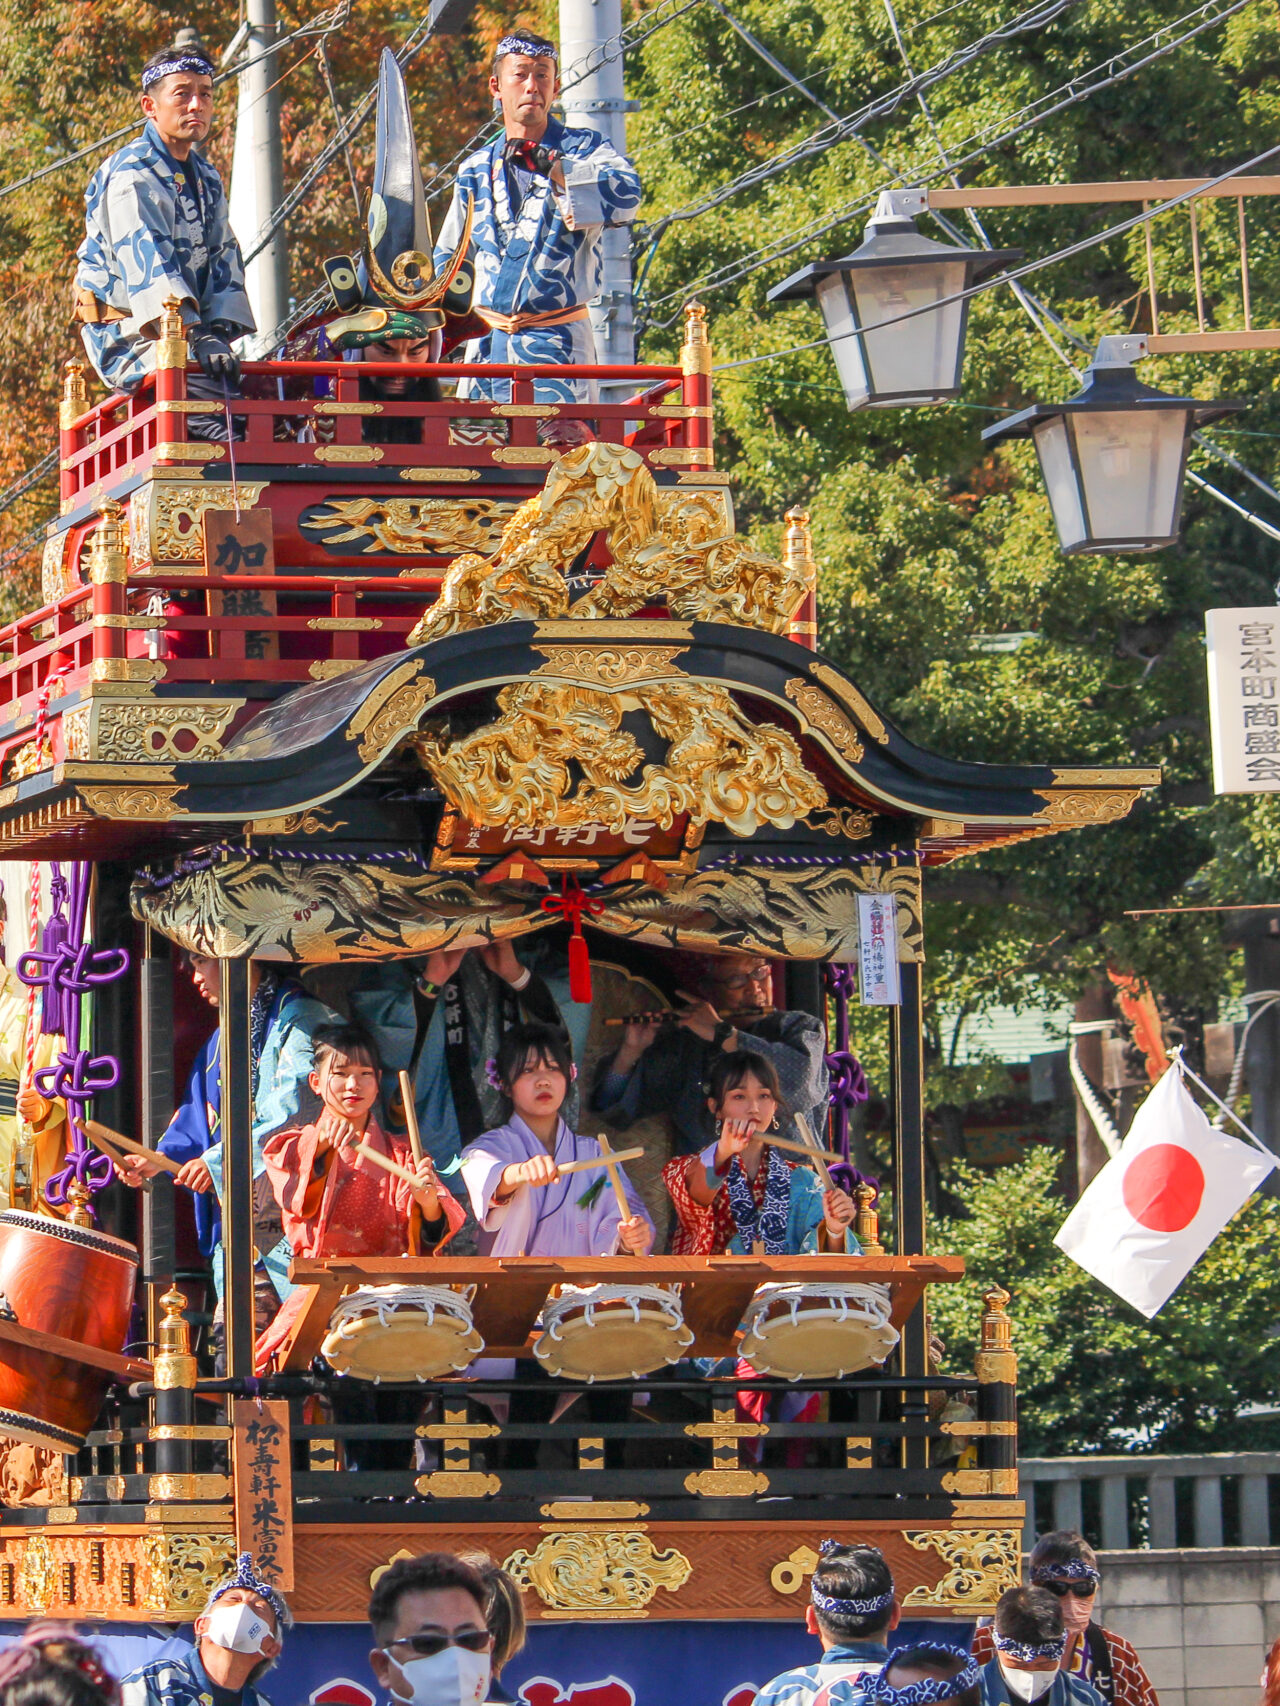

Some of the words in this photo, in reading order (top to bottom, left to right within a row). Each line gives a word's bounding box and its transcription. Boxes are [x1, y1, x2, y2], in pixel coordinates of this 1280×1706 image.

[1238, 621, 1280, 782] 宮本町商盛会
